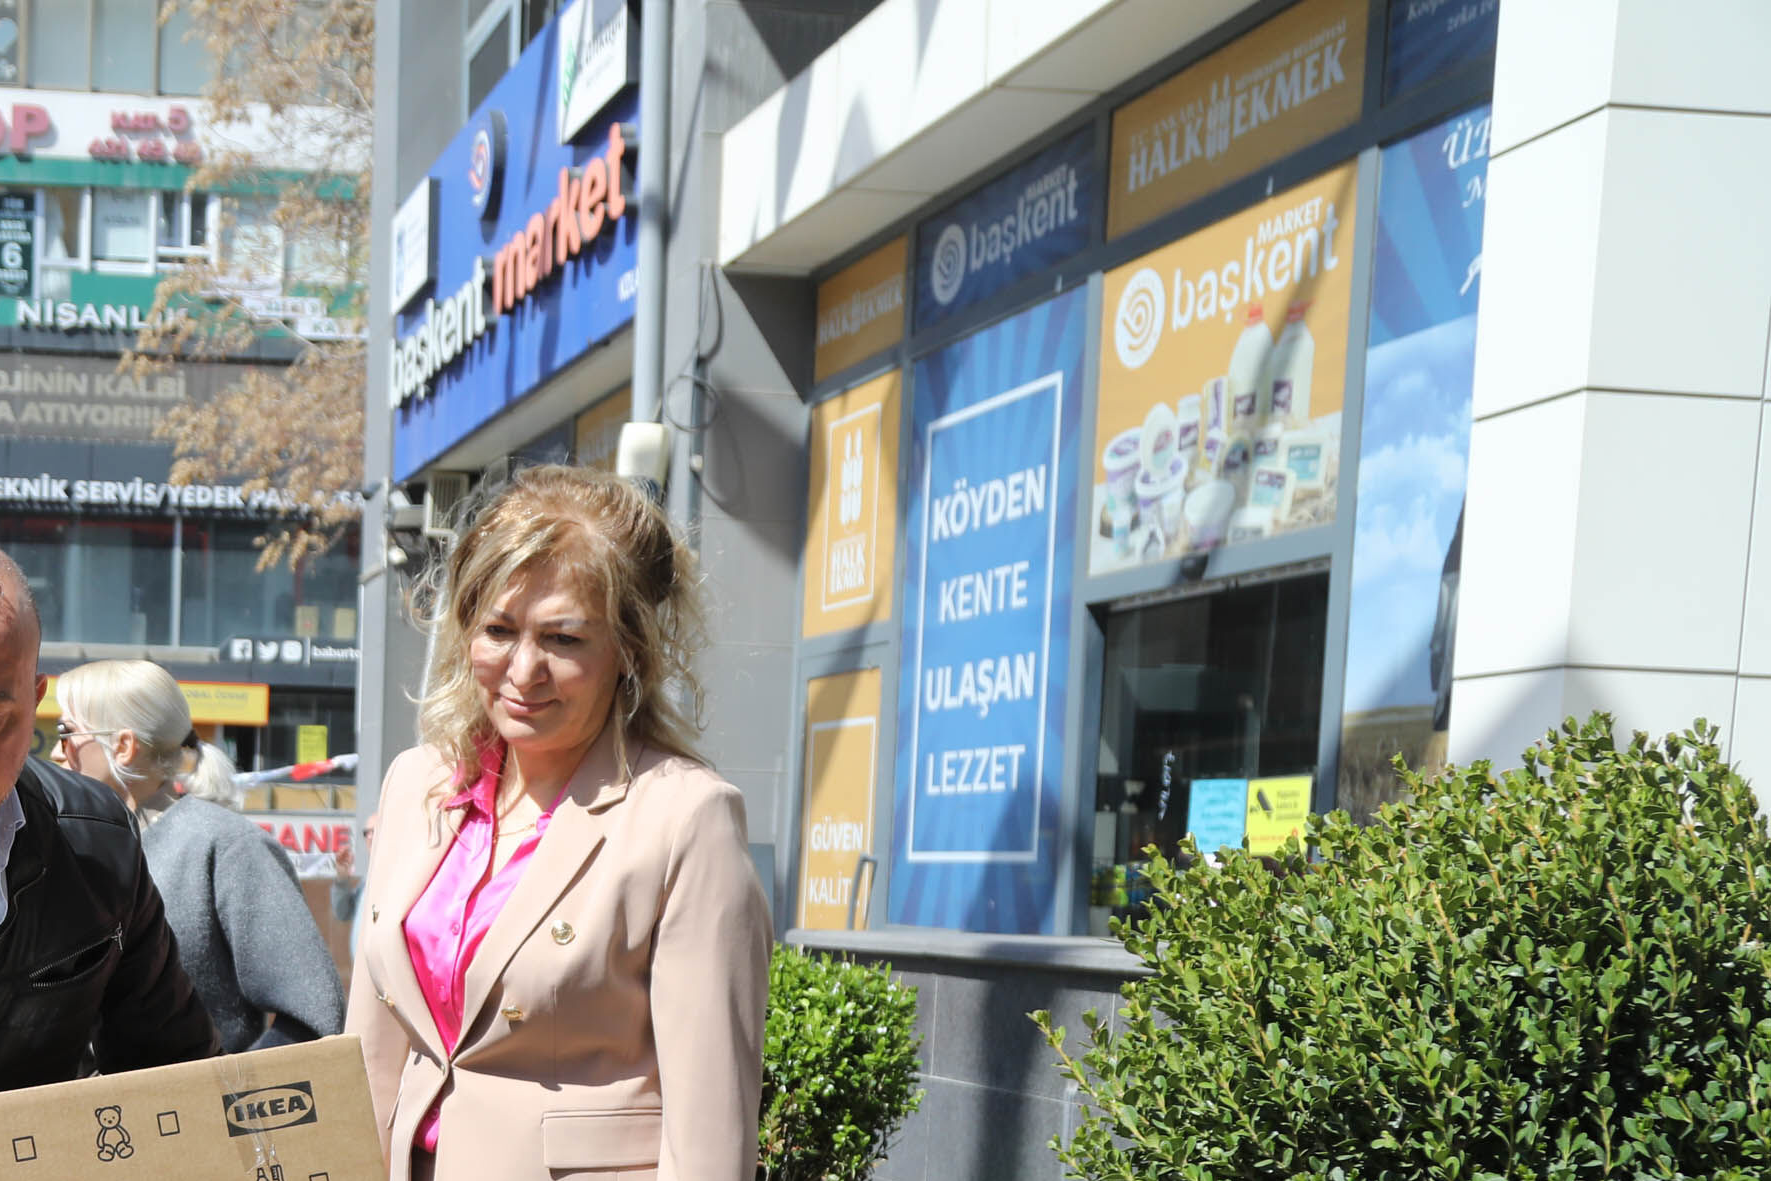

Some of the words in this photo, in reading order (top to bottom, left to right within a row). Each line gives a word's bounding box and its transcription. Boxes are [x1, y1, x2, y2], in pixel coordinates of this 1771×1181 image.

[1128, 116, 1204, 193] HALK
[1231, 37, 1347, 138] EKMEK
[492, 123, 626, 316] market
[969, 169, 1078, 273] başkent
[1258, 197, 1323, 244] MARKET
[1172, 203, 1340, 332] başkent
[390, 255, 488, 410] başkent
[933, 464, 1046, 542] KÖYDEN
[938, 561, 1029, 624] KENTE
[925, 652, 1036, 717] ULAŞAN
[925, 743, 1026, 797] LEZZET
[811, 816, 864, 852] GÜVEN
[808, 871, 860, 906] KALİT
[234, 1093, 309, 1121] IKEA
